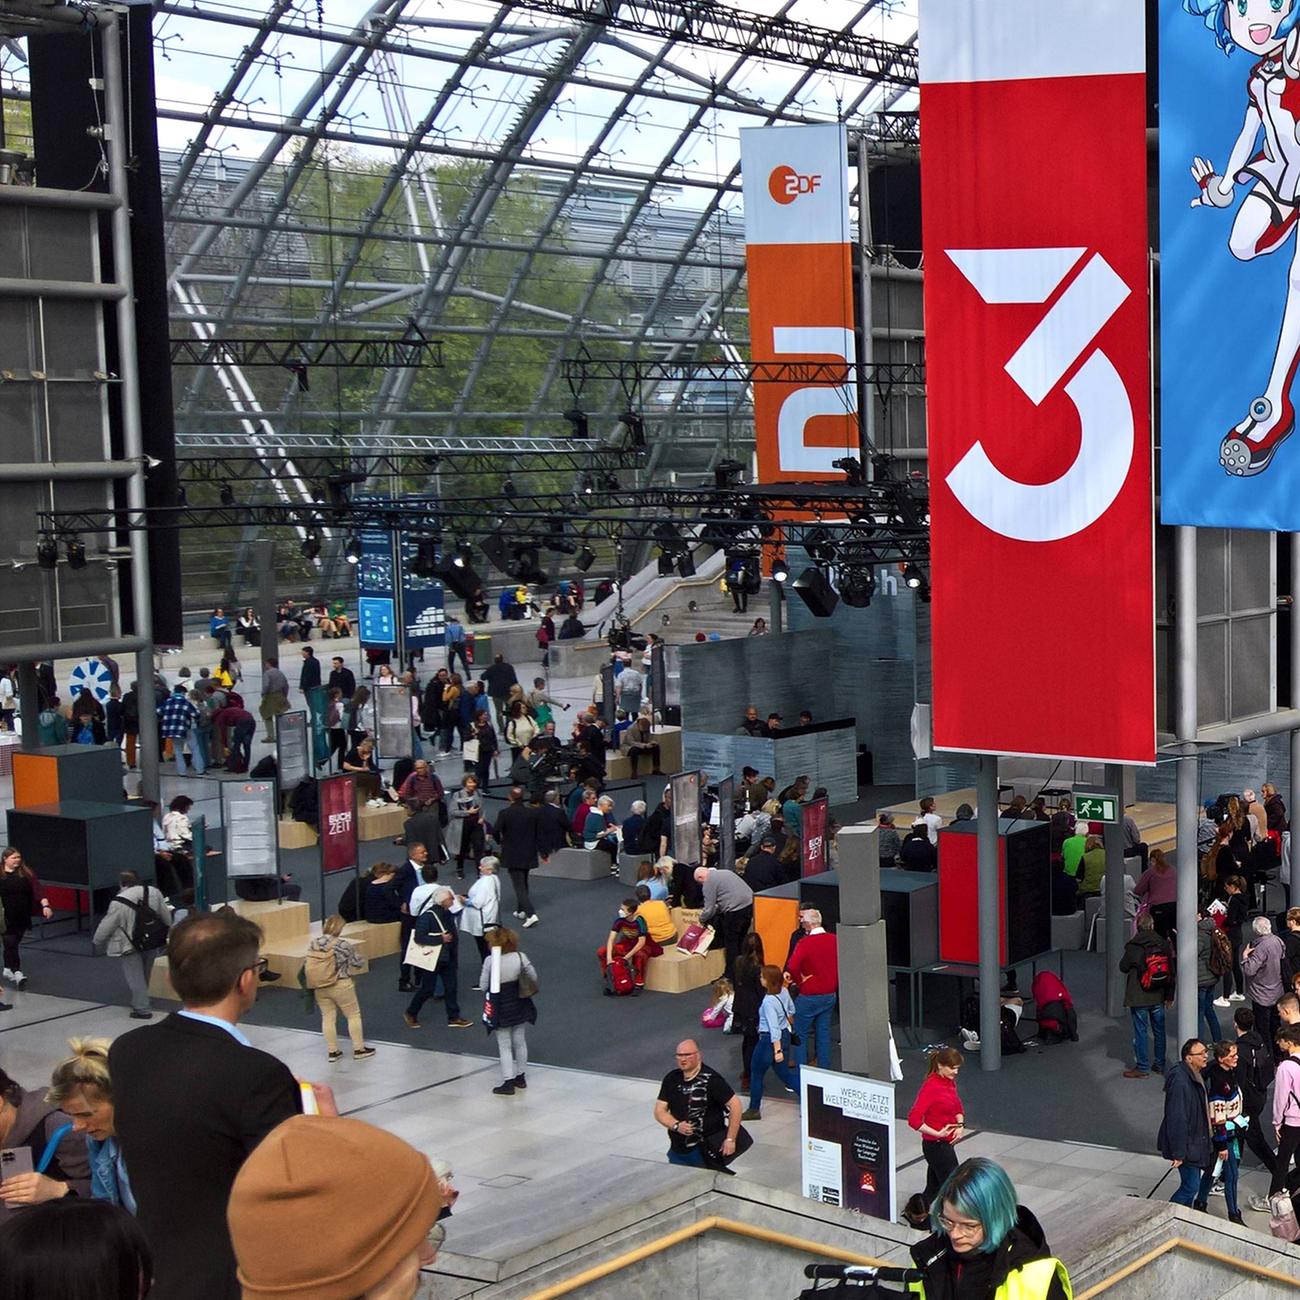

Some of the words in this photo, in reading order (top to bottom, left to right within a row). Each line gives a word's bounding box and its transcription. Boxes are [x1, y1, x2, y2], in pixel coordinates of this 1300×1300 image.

[944, 247, 1135, 542] 3
[328, 820, 351, 835] ZEIT
[825, 1094, 890, 1115] WELTENSAMMLER
[841, 1087, 868, 1101] WERDE
[868, 1094, 889, 1106] JETZT
